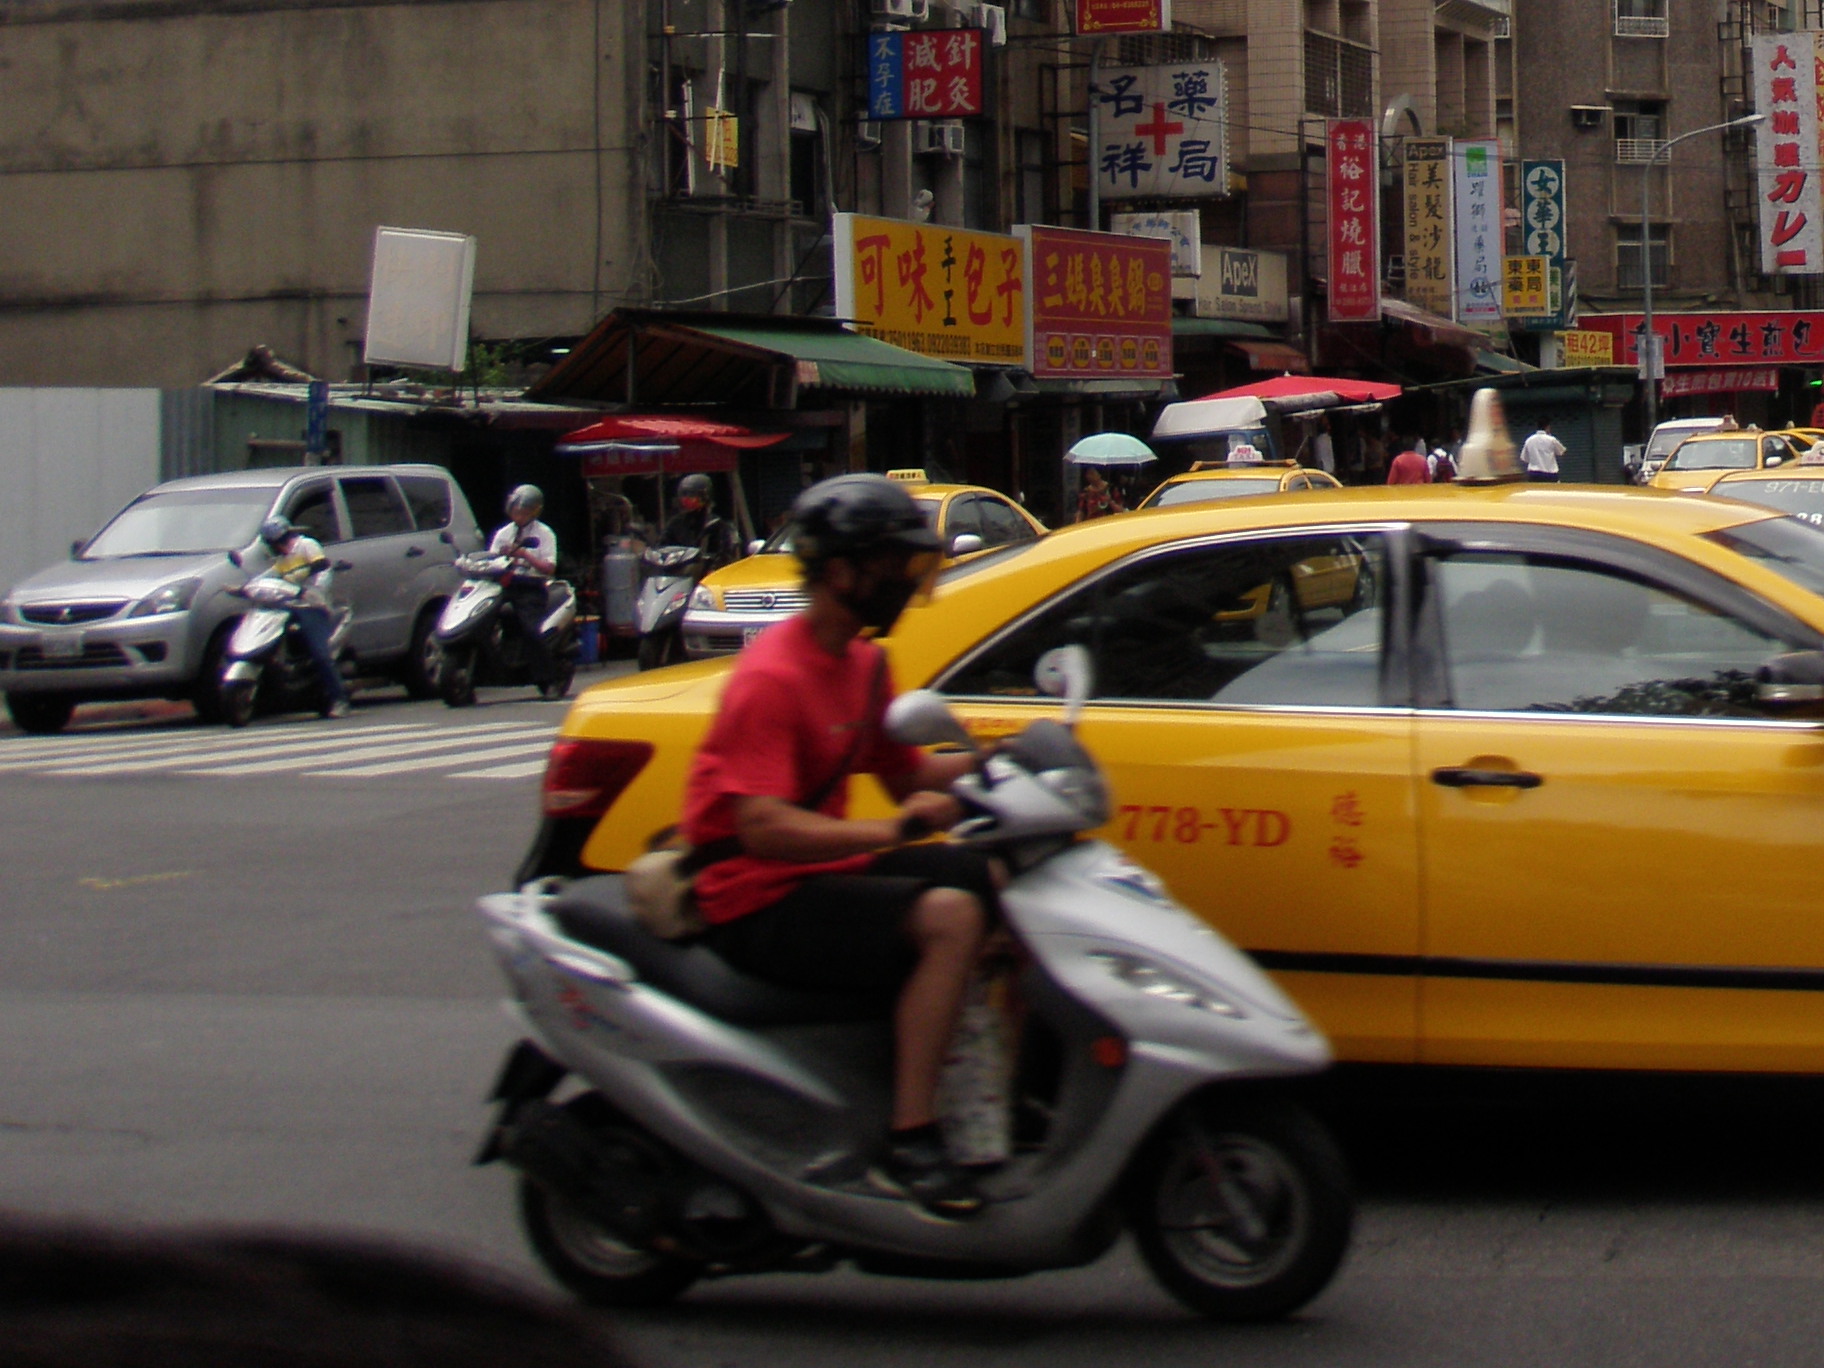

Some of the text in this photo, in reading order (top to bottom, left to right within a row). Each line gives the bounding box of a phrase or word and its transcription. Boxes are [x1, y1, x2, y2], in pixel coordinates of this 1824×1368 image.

[873, 36, 896, 116] 不孕症
[945, 34, 978, 114] 針灸
[1407, 163, 1419, 187] Hair
[1339, 155, 1366, 278] 裕記燒臘
[1408, 194, 1420, 228] salon
[1421, 162, 1447, 281] 美髮沙龍
[1042, 251, 1146, 317] 三媽臭臭鍋
[1408, 249, 1420, 281] style
[1118, 803, 1293, 849] 778-YD
